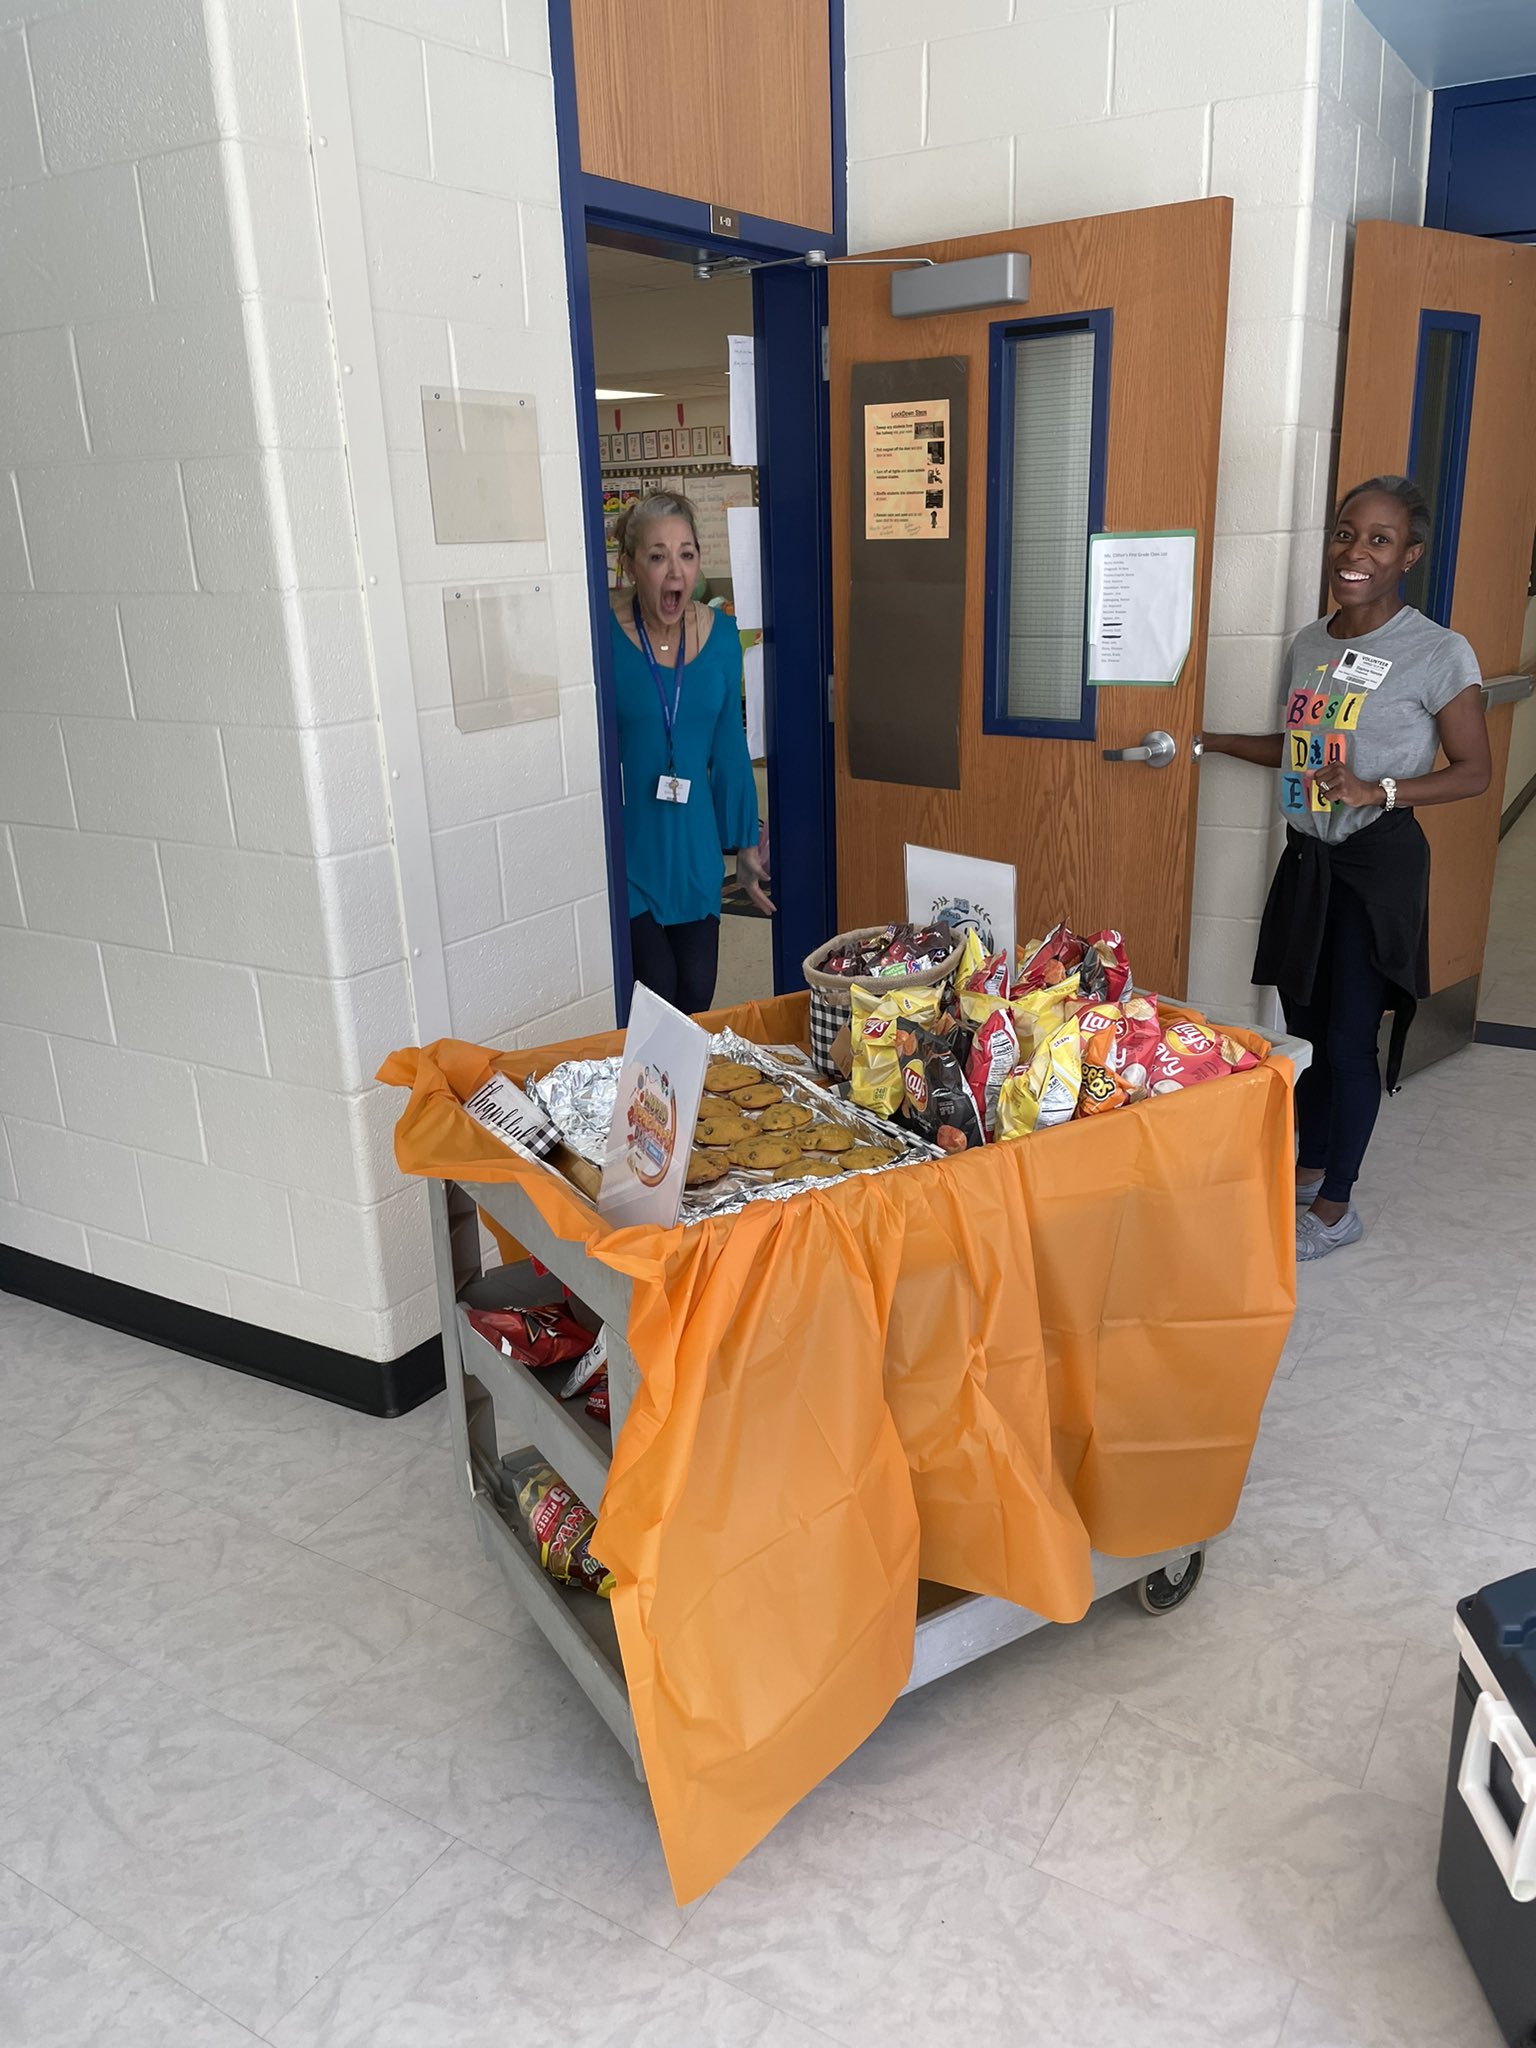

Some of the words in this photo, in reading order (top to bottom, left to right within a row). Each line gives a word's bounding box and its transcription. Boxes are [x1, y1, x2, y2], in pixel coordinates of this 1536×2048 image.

[1287, 694, 1356, 724] Best
[1172, 1023, 1212, 1050] Lay's
[467, 1081, 538, 1141] thankful
[549, 1486, 571, 1506] 5
[537, 1501, 558, 1534] PIECES
